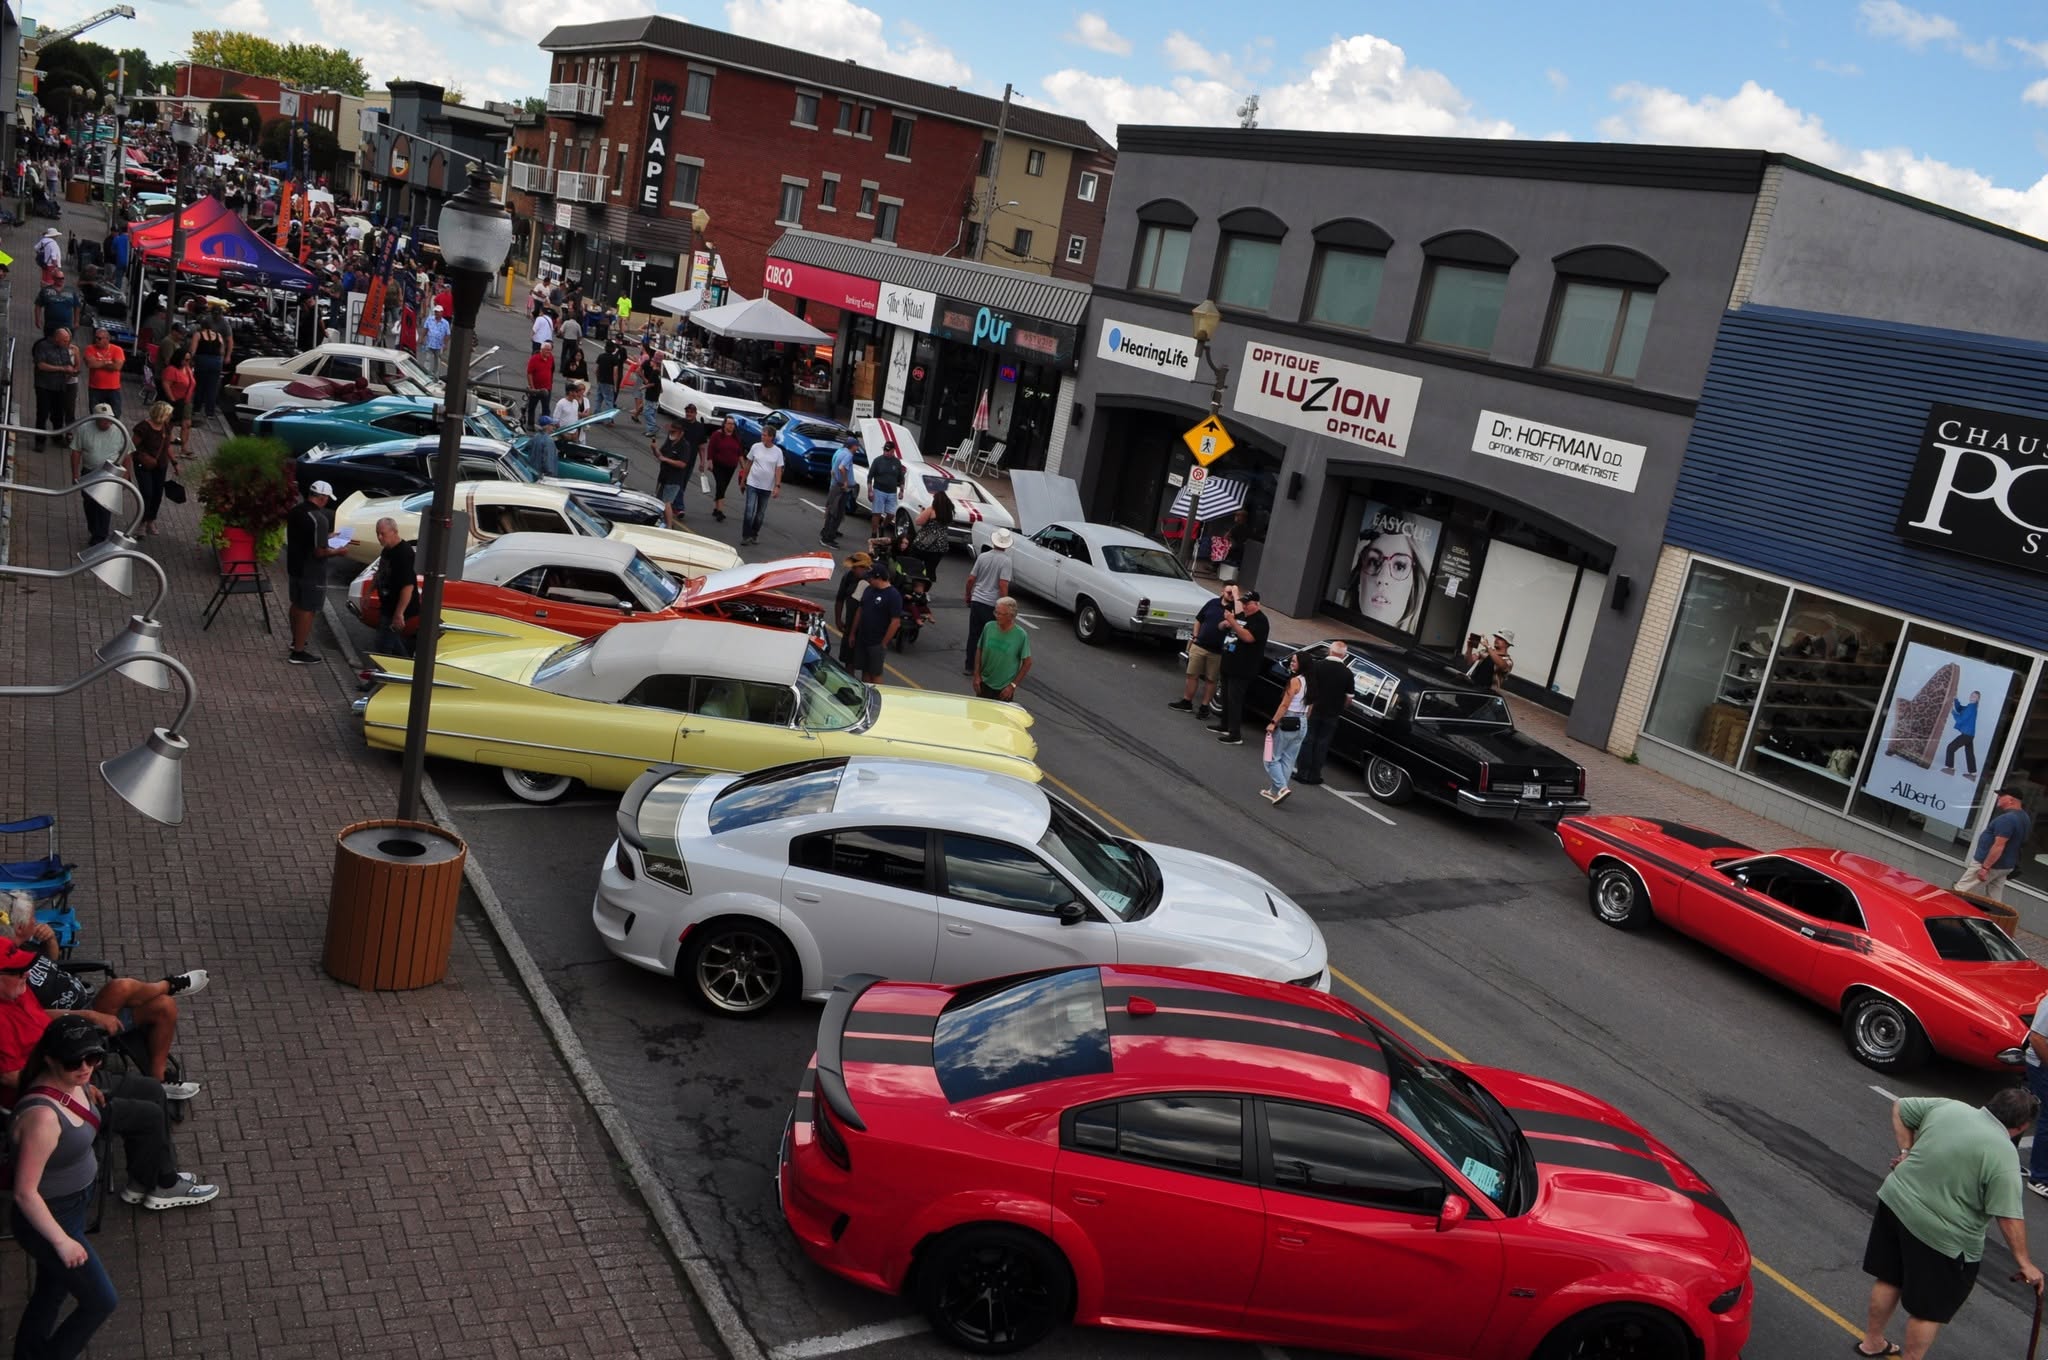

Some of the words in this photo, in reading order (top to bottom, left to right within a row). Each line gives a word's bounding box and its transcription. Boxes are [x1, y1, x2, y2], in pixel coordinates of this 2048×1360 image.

[644, 112, 670, 203] VAPE
[202, 255, 258, 268] MOPAR
[765, 265, 785, 286] CIBC
[845, 294, 861, 308] Banking
[861, 298, 875, 310] Centre
[887, 292, 899, 315] The
[902, 293, 925, 321] Ritual
[1120, 336, 1188, 368] HearingLife
[1252, 348, 1320, 374] OPTIQUE
[1260, 370, 1390, 424] ILUZION
[1326, 418, 1397, 448] OPTICAL
[1492, 420, 1512, 440] Dr.
[1516, 425, 1602, 462] HOFFMAN
[1602, 451, 1623, 467] O.D.
[1488, 441, 1545, 463] OPTOMETRIST
[1552, 457, 1619, 482] OPTOMÉTRISTE
[1890, 780, 1946, 810] Alberto
